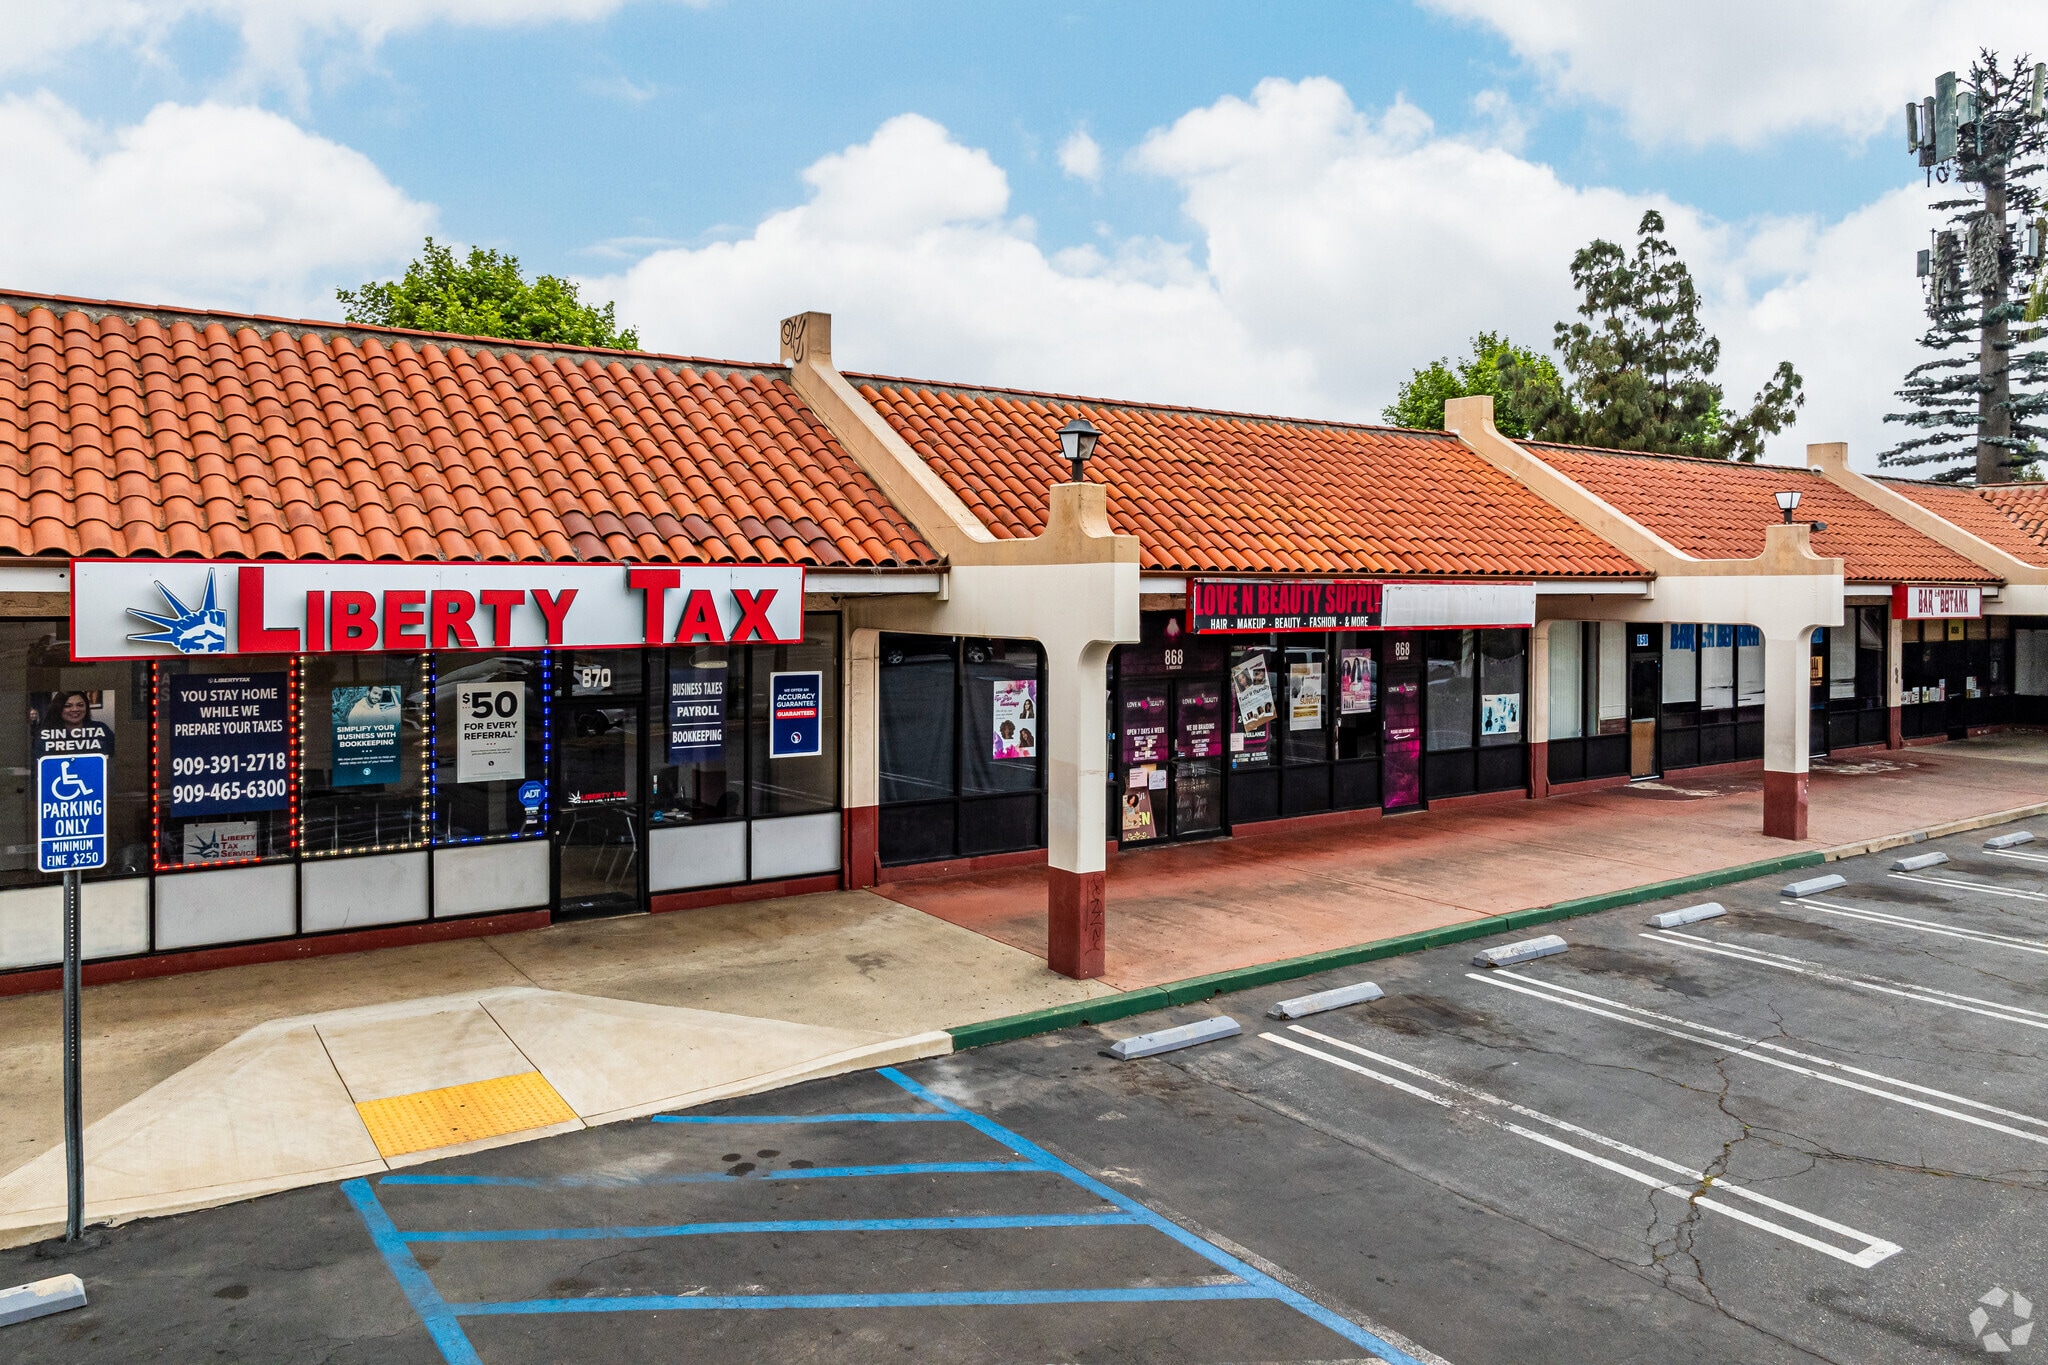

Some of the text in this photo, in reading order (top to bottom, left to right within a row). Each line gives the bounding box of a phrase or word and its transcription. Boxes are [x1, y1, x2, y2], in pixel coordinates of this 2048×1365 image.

[1195, 584, 1382, 616] LOVE N BEAUTY SUPPLY
[1918, 589, 1934, 616] BAR
[1940, 589, 1969, 613] BOTANA
[238, 566, 779, 652] LIBERTY TAX
[1210, 618, 1228, 630] HAIR
[1237, 617, 1266, 629] MAKEUP
[1274, 617, 1301, 628] BEAUTY
[1309, 616, 1337, 627] FASHION
[1344, 616, 1350, 627] &
[1351, 615, 1369, 627] MORE
[1395, 642, 1410, 656] 868
[1164, 649, 1183, 665] 868
[582, 668, 611, 688] 870
[181, 690, 207, 702] YOU
[210, 689, 239, 701] STAY
[242, 688, 278, 700] HOME
[672, 681, 723, 696] BUSINESS TAXES
[777, 693, 816, 701] ACCURACY
[1299, 697, 1320, 705] SUNDAY
[200, 705, 260, 718] WHILE WE
[462, 691, 518, 719] $50
[676, 705, 720, 718] PAYROLL
[175, 720, 283, 736] PREPARE YOUR TAXES
[336, 725, 372, 733] SIMPLIFY
[464, 721, 518, 731] FOR EVERY
[41, 727, 106, 740] SIN CITA
[337, 732, 375, 740] BUSINESS
[672, 729, 722, 743] BOOKKEEPING
[45, 739, 102, 751] PREVIA
[339, 739, 394, 748] BOOKKEEPING
[172, 752, 286, 776] 909-391-2718
[172, 779, 287, 804] 909-465-6300
[523, 788, 541, 799] ADT
[580, 791, 611, 800] LIBERTY
[42, 800, 102, 819] PARKING
[55, 818, 90, 836] ONLY
[52, 839, 93, 853] MINIMUM
[221, 849, 256, 857] SERVICE
[46, 852, 99, 867] FINE $250
